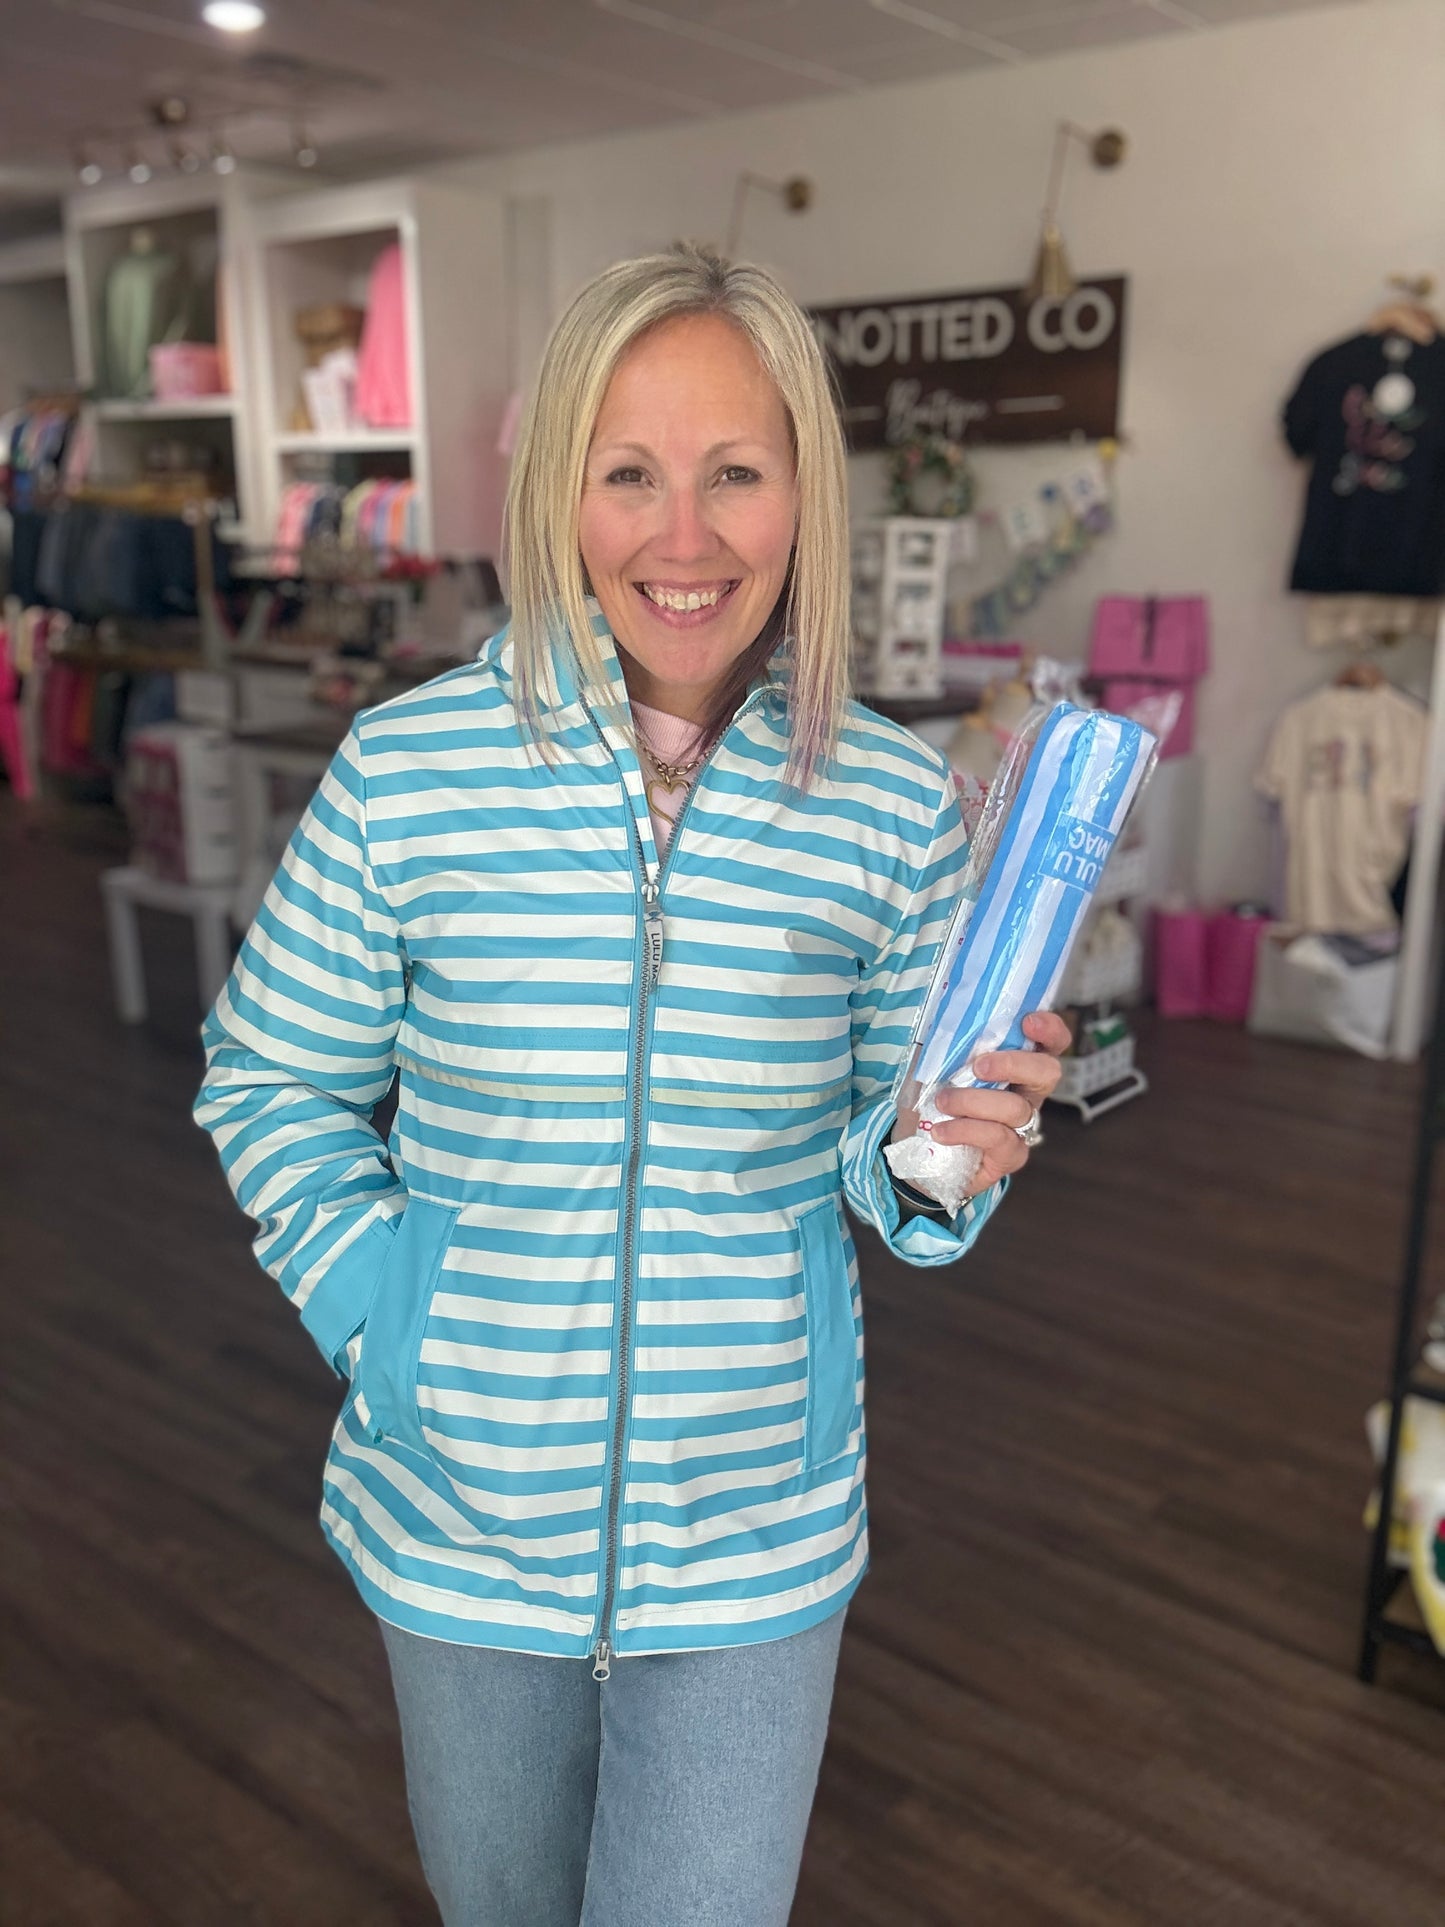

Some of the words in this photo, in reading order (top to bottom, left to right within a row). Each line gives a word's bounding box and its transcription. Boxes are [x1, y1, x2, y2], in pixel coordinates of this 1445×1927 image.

[1027, 287, 1115, 353] CO
[1069, 826, 1112, 861] MAC
[651, 933, 661, 961] LULU
[651, 964, 659, 983] MA
